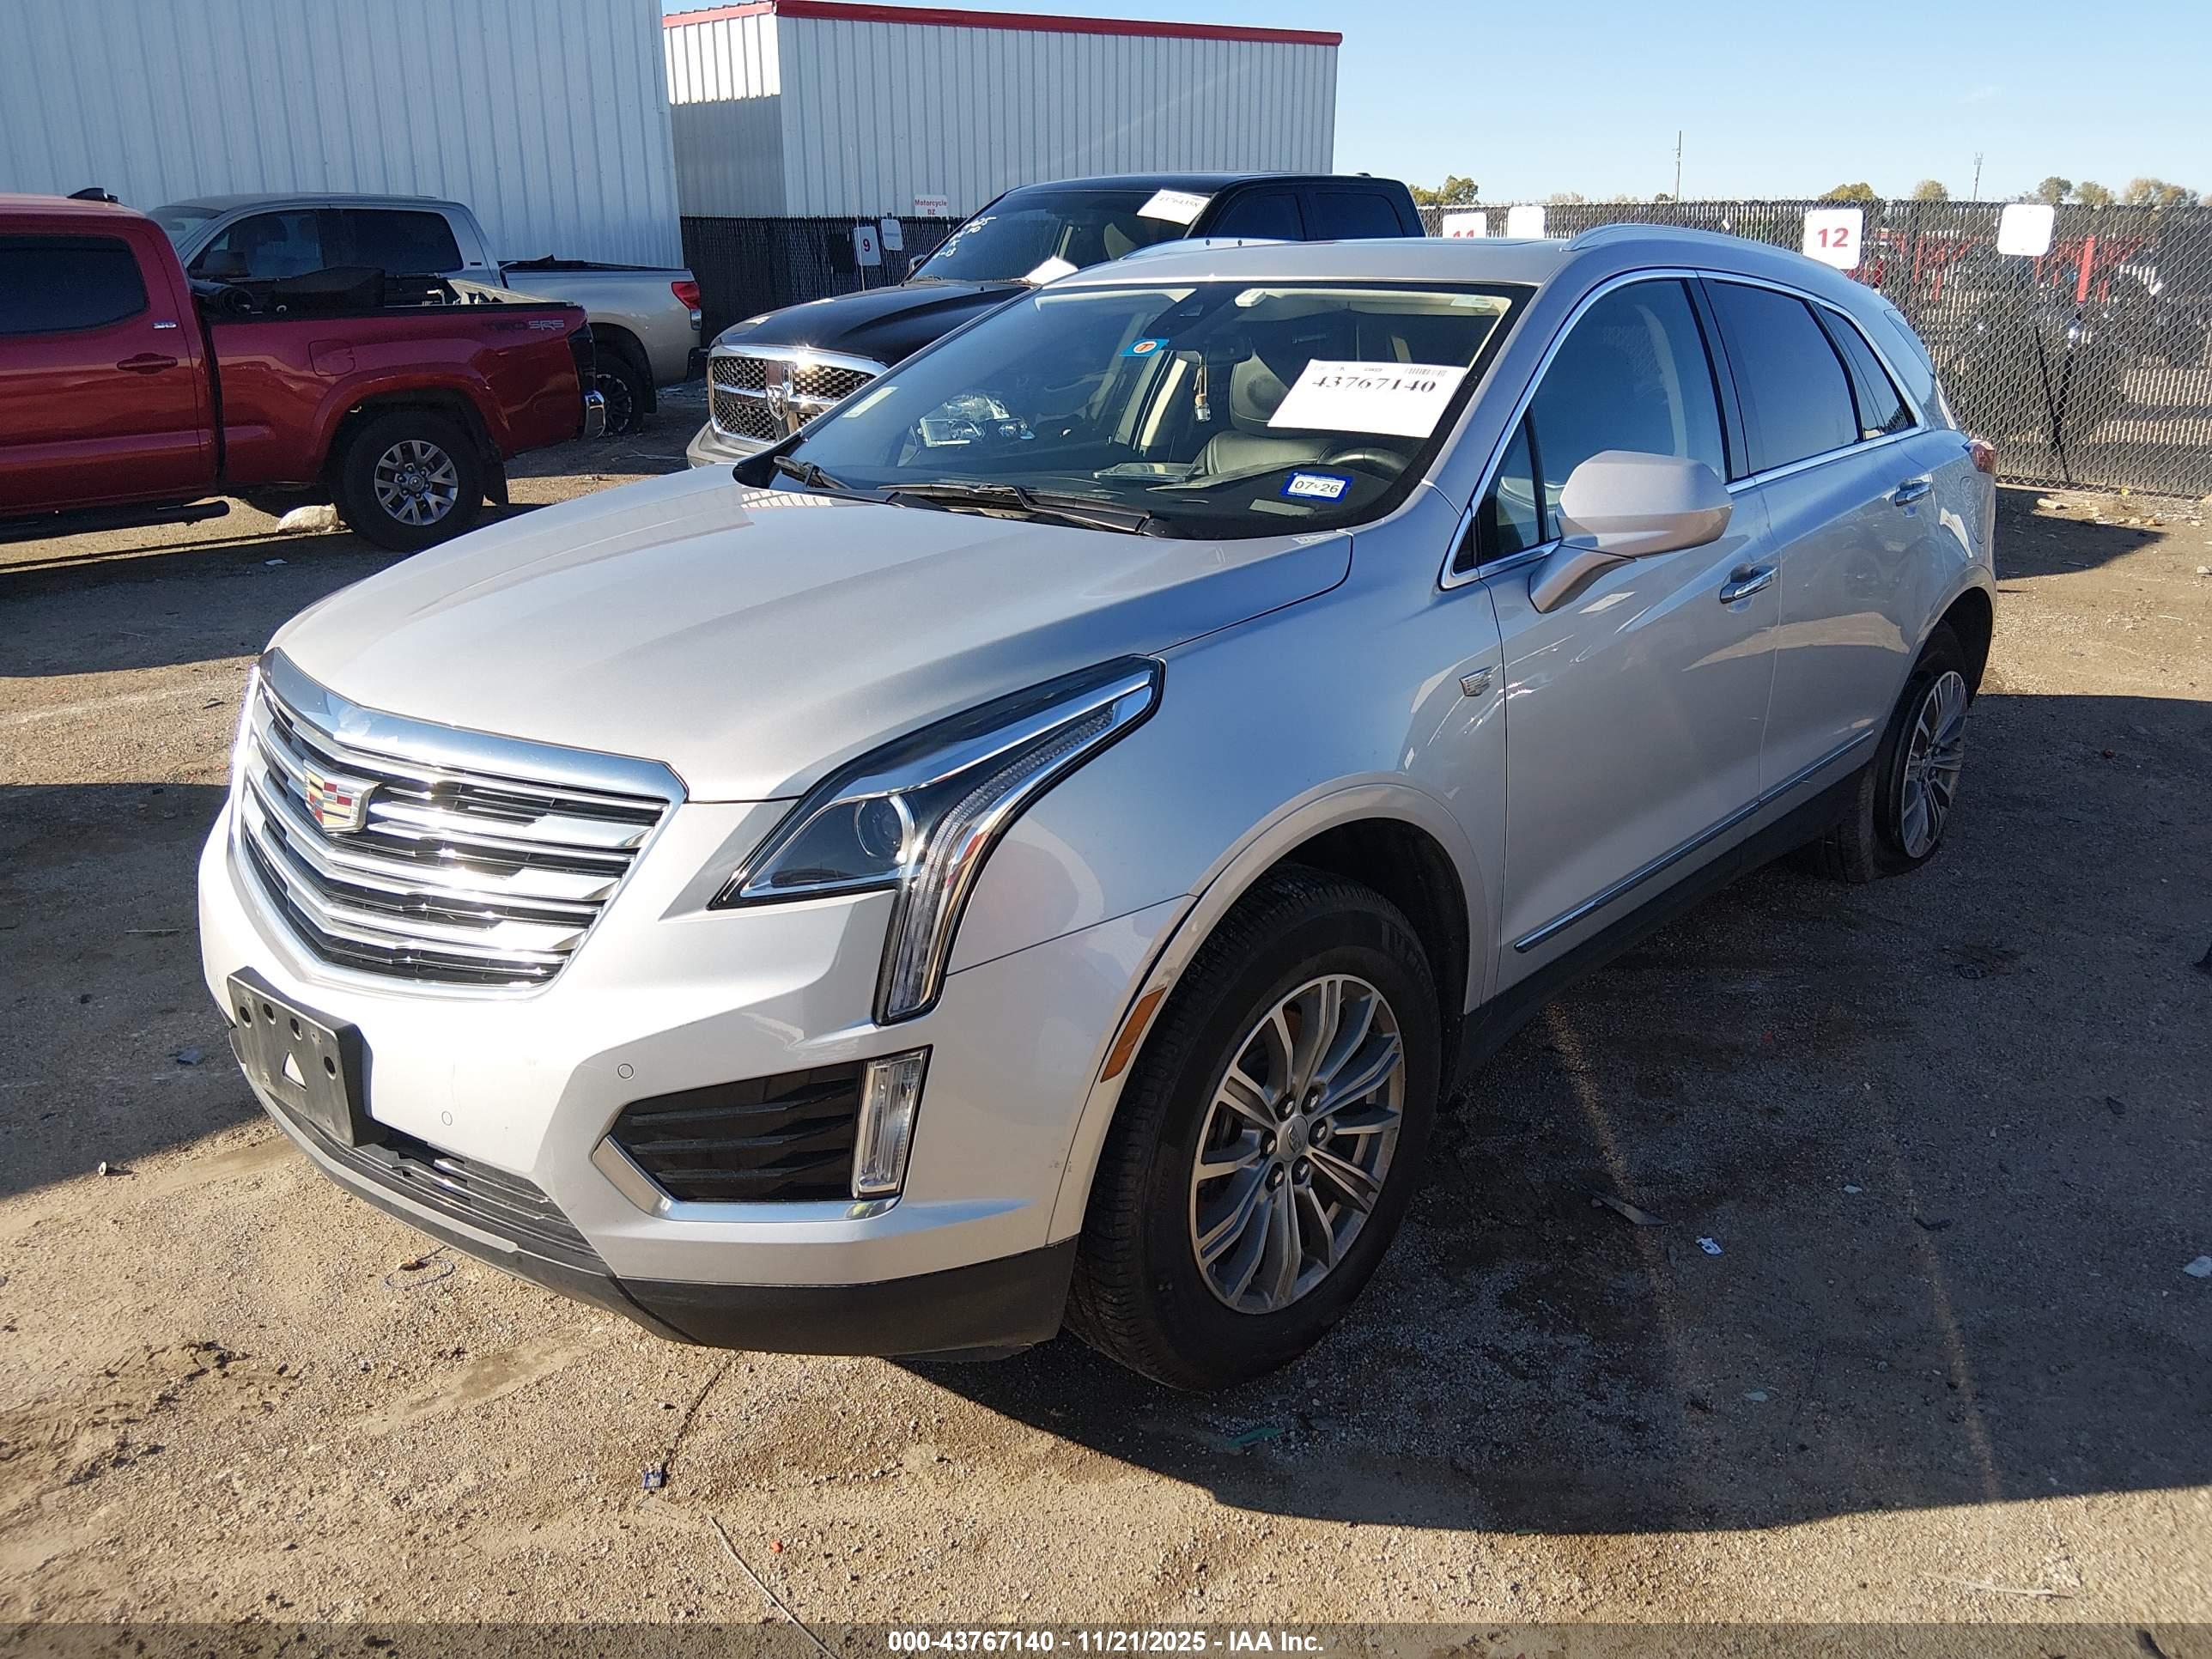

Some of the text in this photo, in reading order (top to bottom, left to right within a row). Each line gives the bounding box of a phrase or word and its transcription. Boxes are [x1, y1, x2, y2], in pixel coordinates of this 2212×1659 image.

[862, 238, 871, 252] 9
[1817, 228, 1849, 248] 12
[1312, 376, 1437, 393] 43767140
